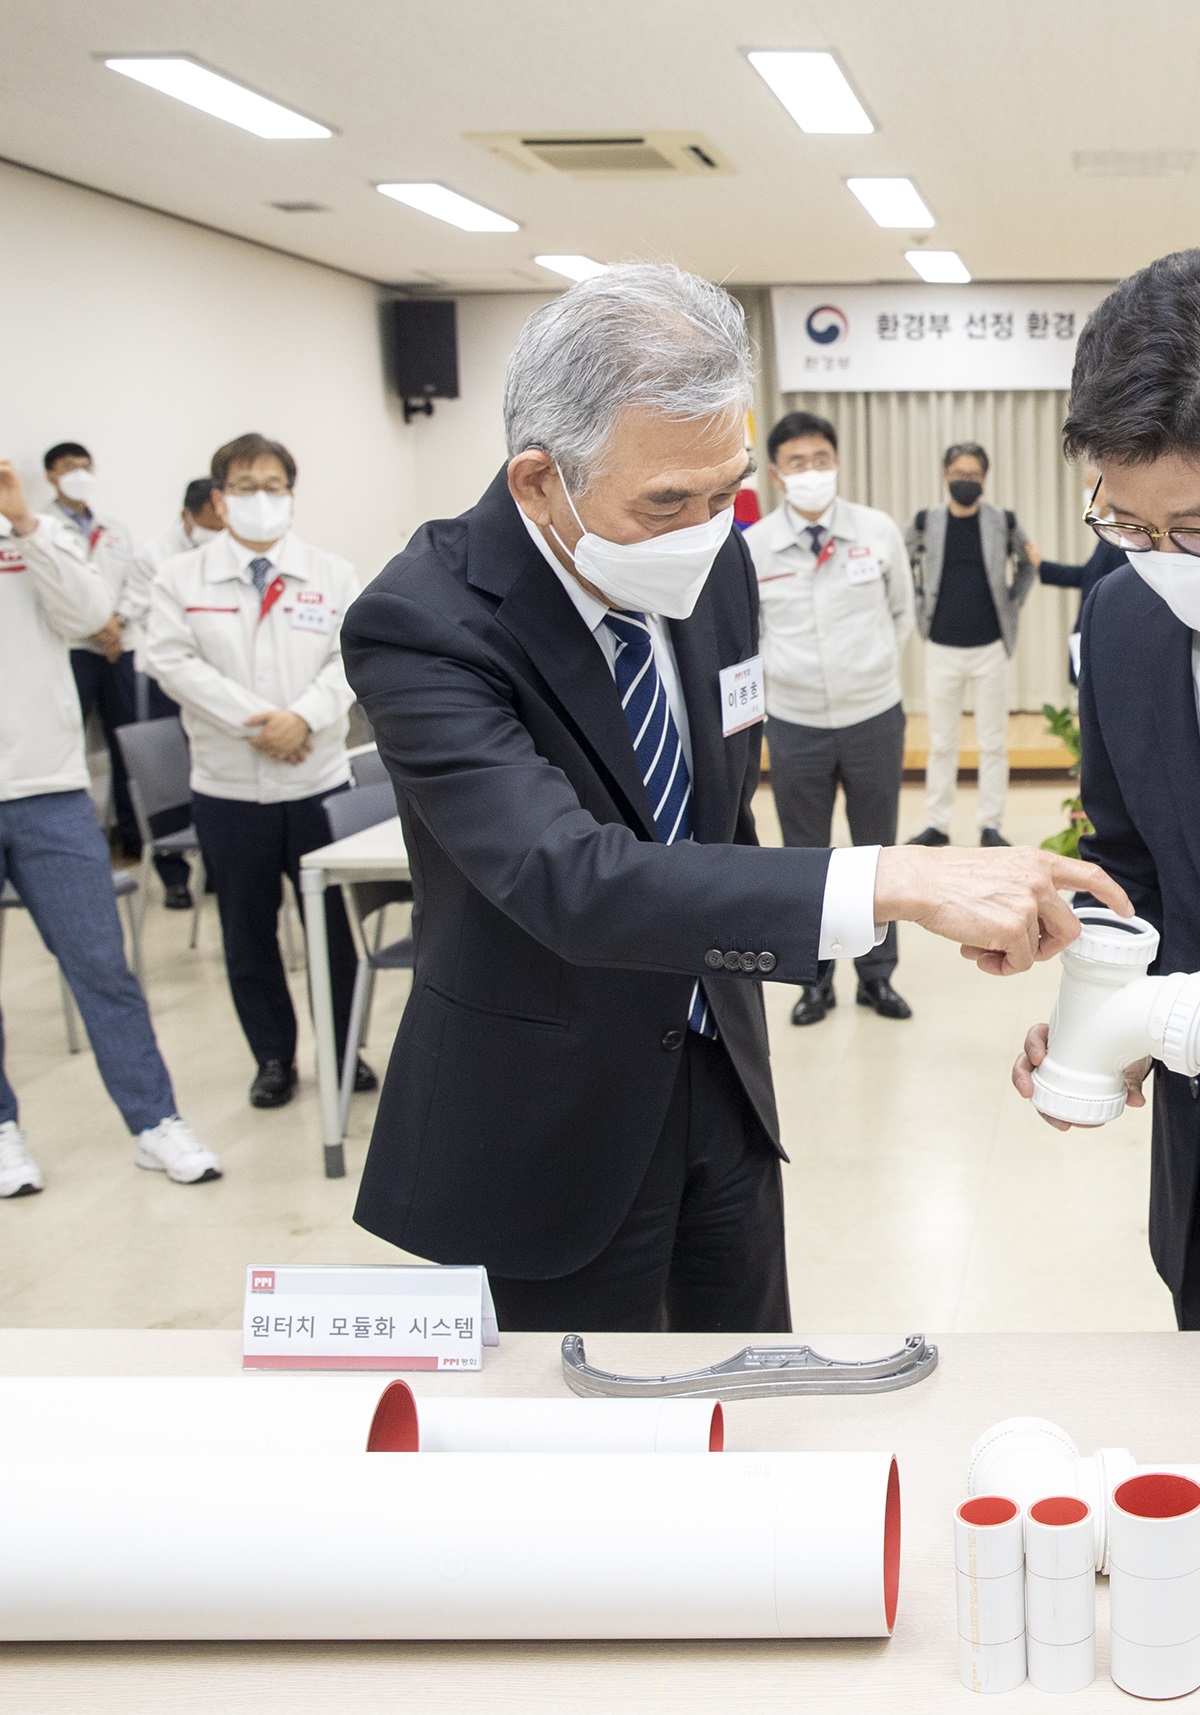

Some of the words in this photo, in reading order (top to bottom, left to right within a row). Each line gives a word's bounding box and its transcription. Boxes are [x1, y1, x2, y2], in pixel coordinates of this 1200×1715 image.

[878, 312, 950, 340] 환경부
[965, 312, 1014, 340] 선정
[254, 1277, 273, 1288] PPI
[251, 1315, 316, 1339] 원터치
[329, 1316, 396, 1340] 모듈화
[408, 1316, 475, 1340] 시스템
[443, 1358, 460, 1366] PPI
[461, 1358, 477, 1367] 평화
